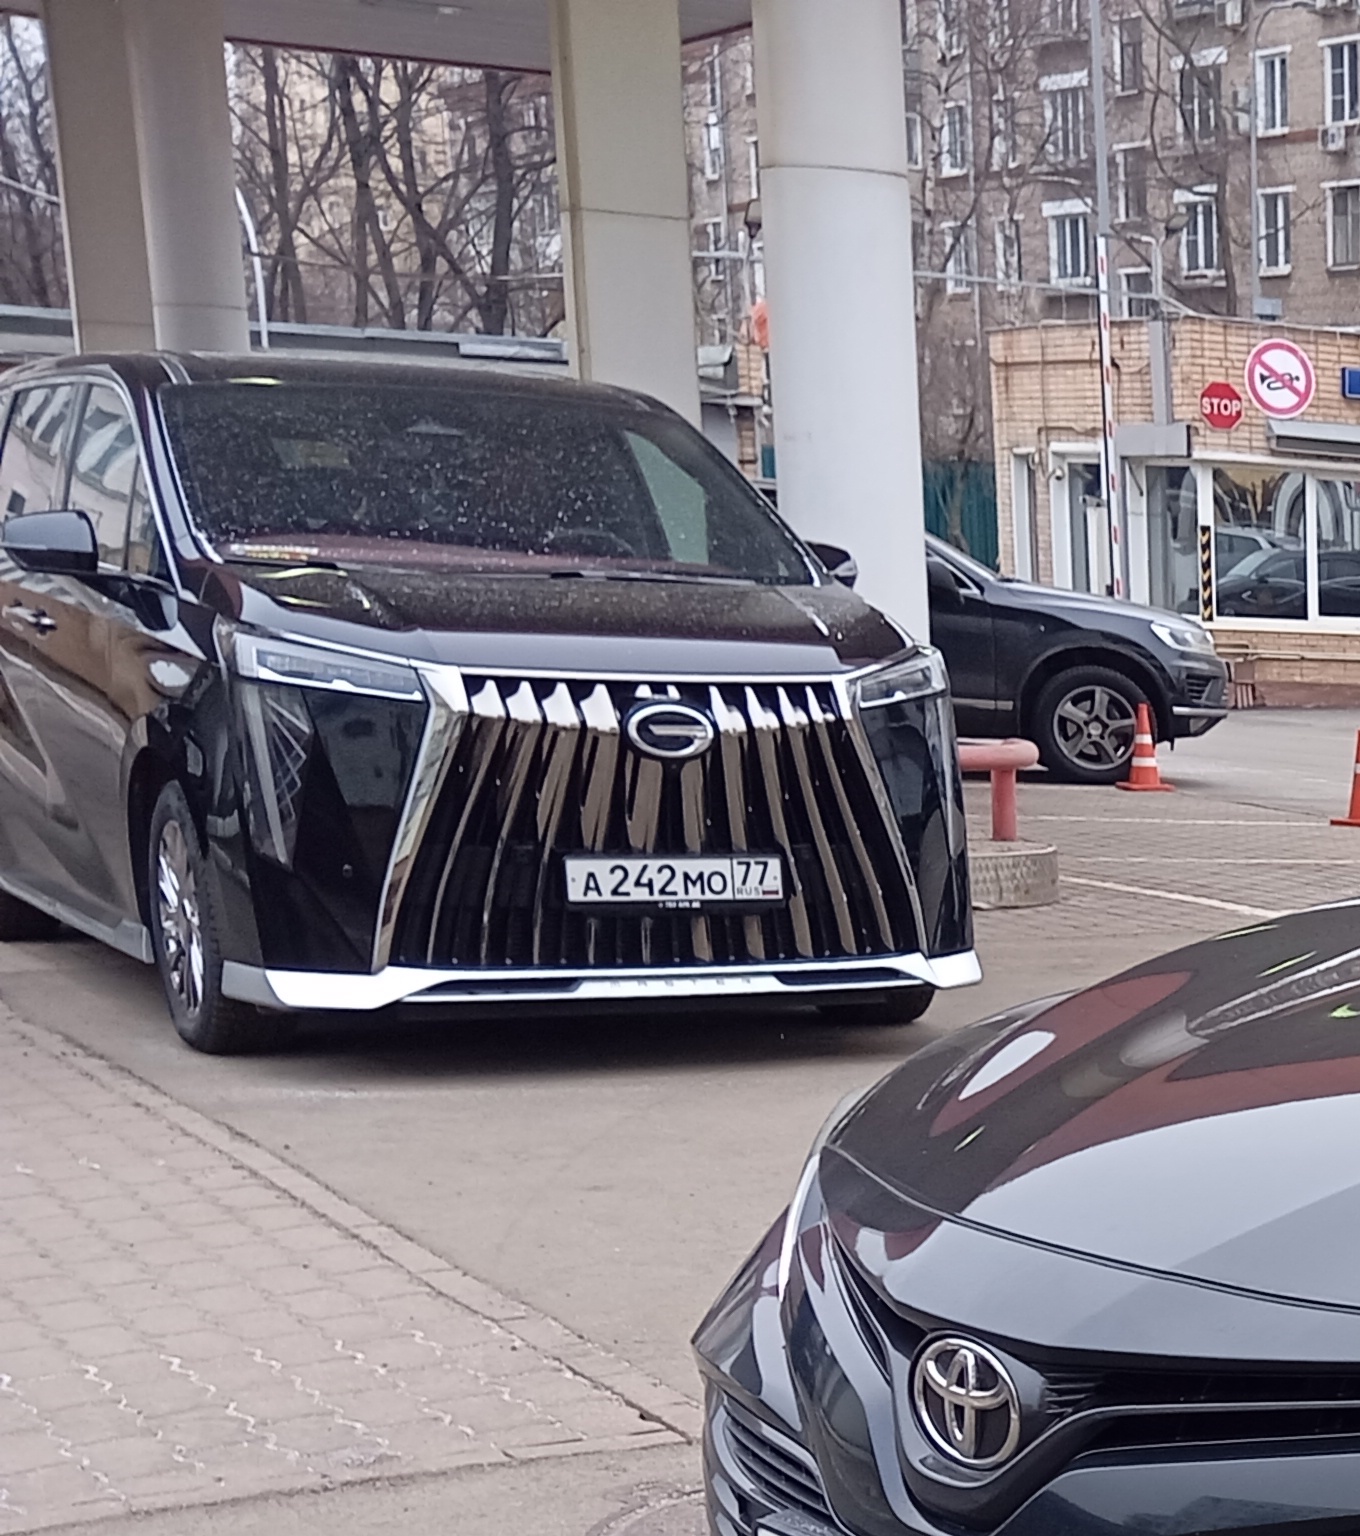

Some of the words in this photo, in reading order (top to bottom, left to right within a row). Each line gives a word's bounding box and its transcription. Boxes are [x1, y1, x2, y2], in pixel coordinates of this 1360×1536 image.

[1202, 396, 1241, 417] STOP
[736, 861, 769, 887] 77
[736, 887, 761, 896] RUS
